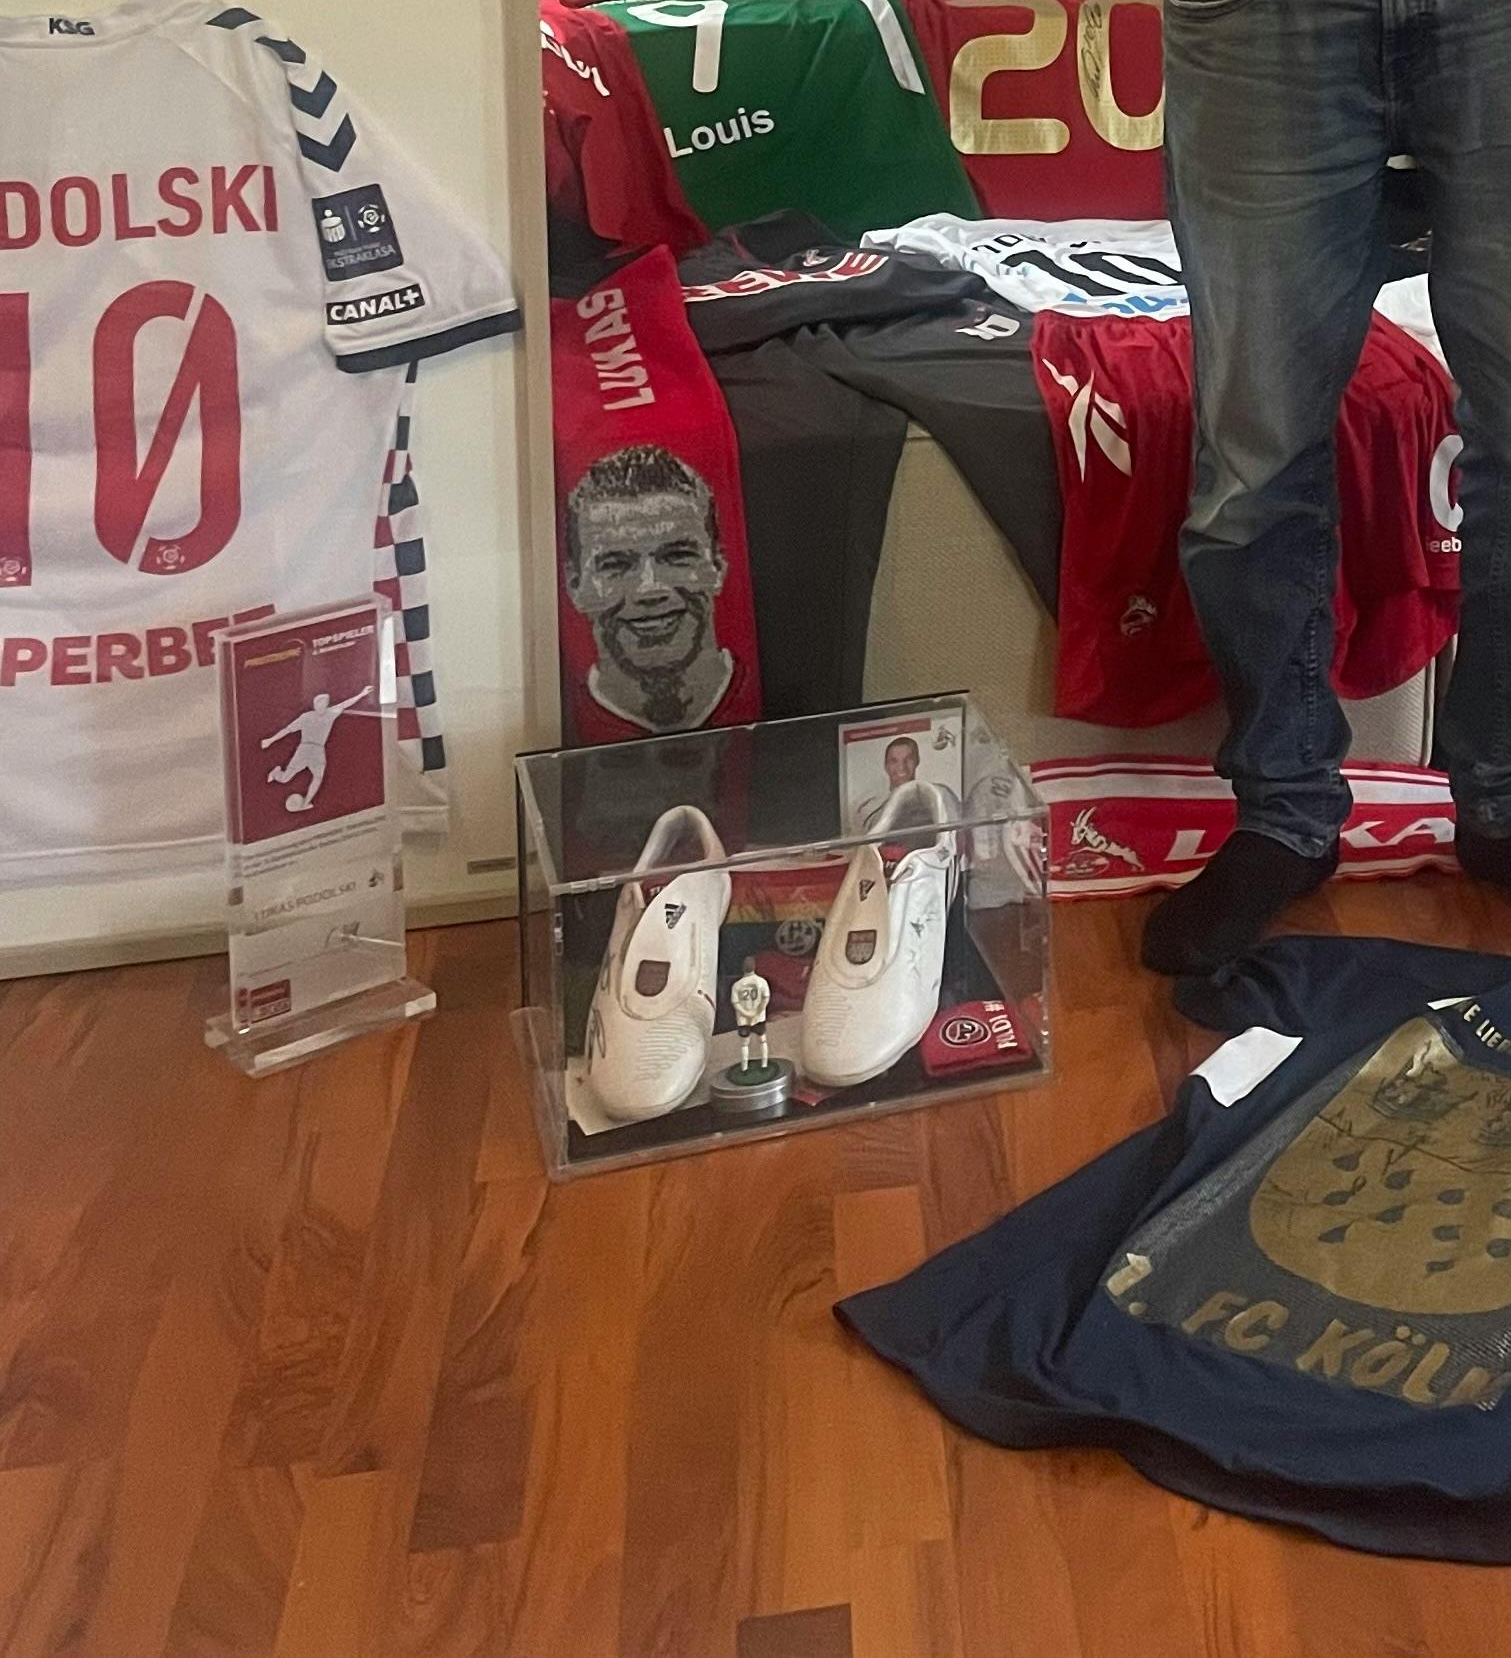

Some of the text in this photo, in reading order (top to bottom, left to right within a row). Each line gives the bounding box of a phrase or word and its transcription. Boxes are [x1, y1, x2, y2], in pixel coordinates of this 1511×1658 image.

[663, 105, 775, 159] Louis
[0, 164, 279, 251] DOLSKI
[330, 288, 420, 322] CANAL+
[576, 287, 656, 411] LUKAS
[0, 603, 276, 687] PERBE
[1180, 1291, 1289, 1351] FC
